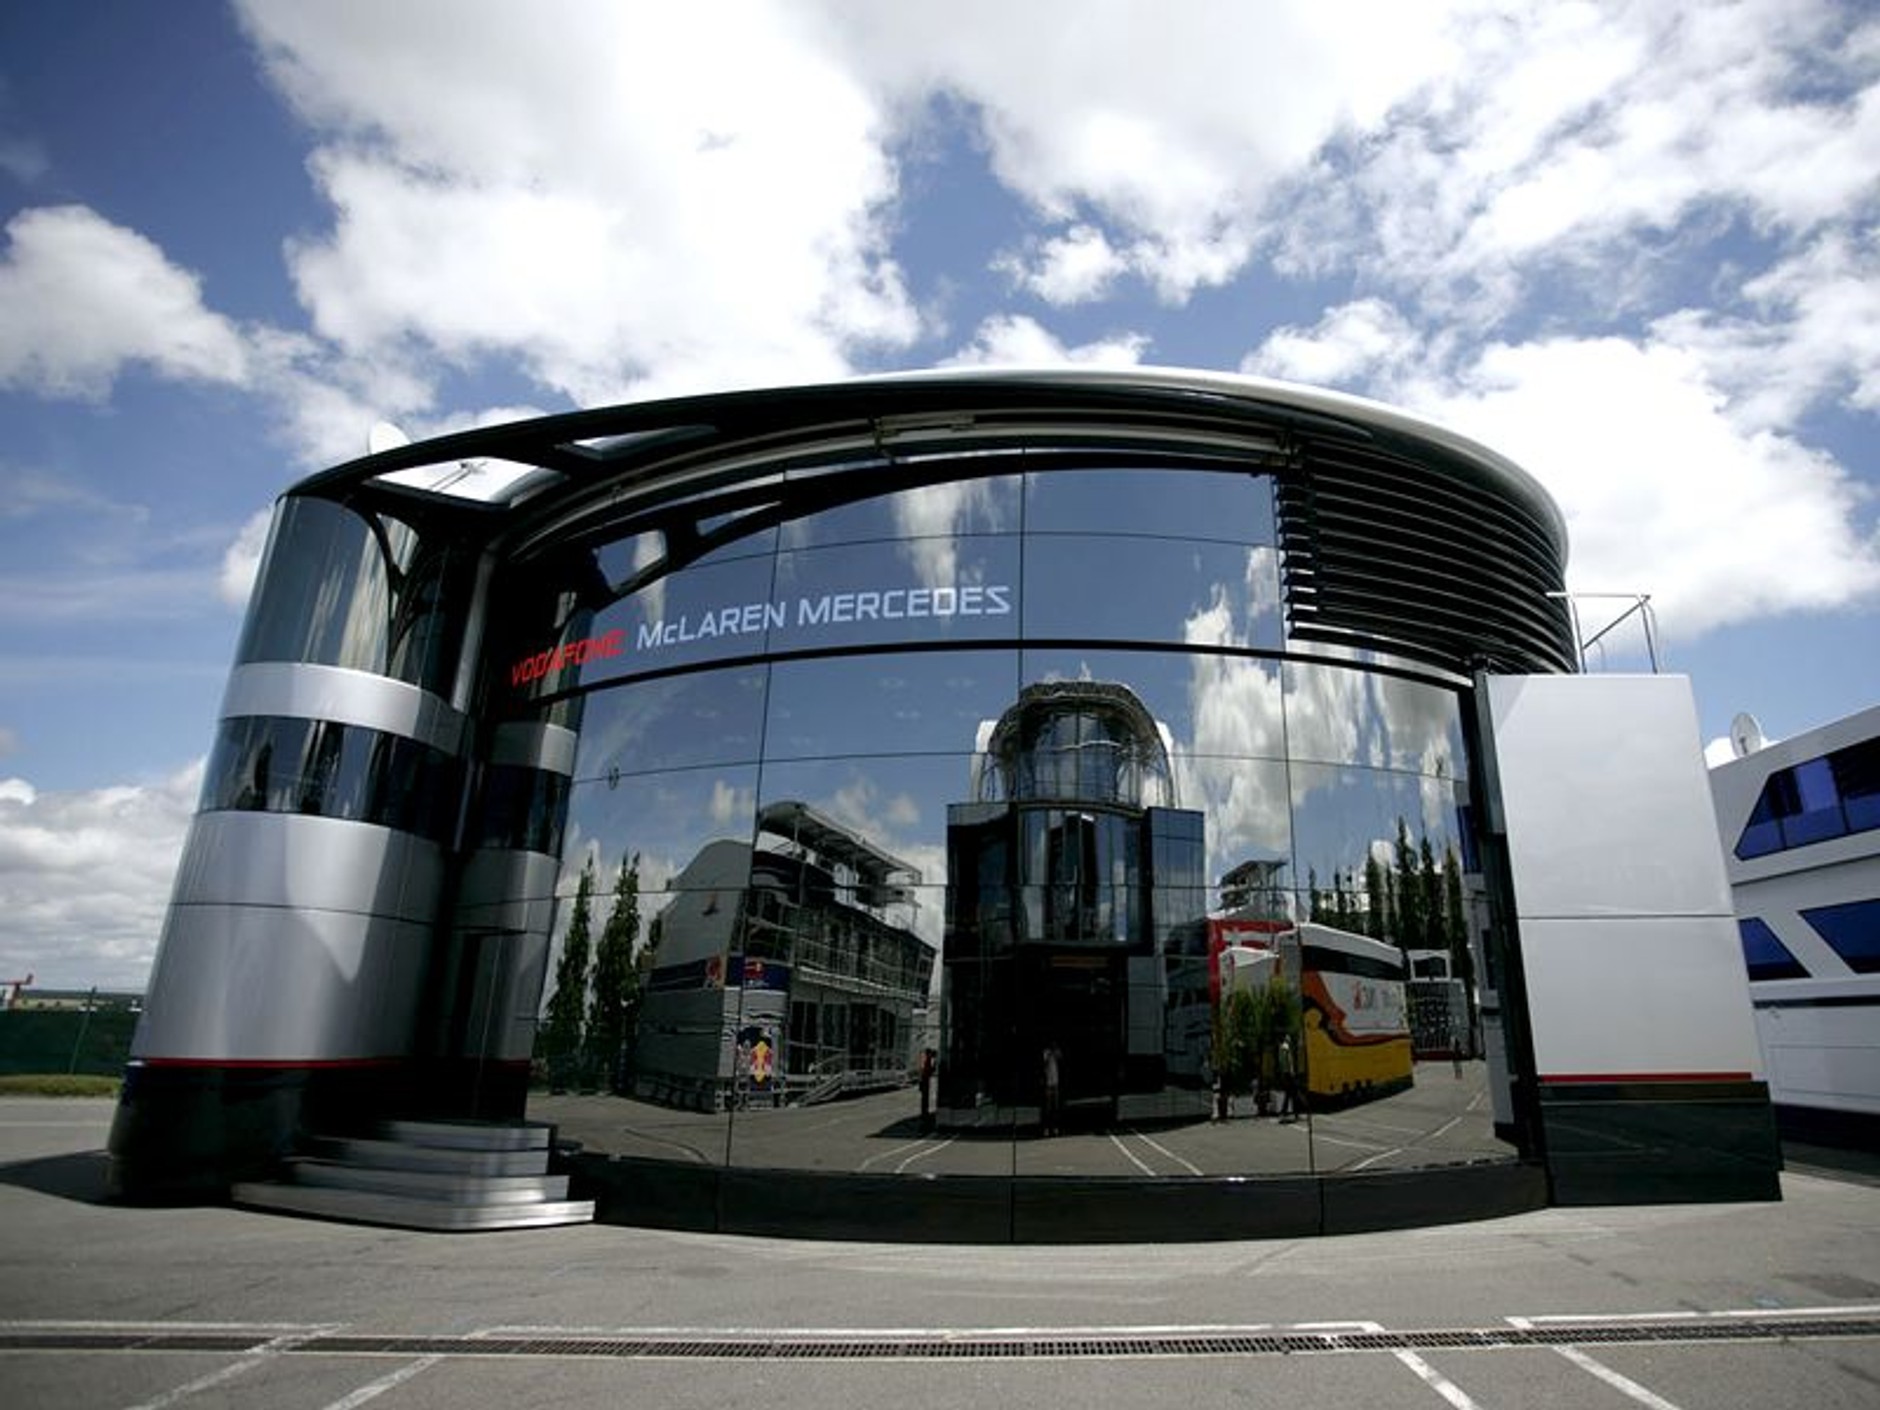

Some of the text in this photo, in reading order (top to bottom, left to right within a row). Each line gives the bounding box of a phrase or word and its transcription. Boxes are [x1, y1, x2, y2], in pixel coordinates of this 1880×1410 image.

[512, 586, 1012, 688] VODAFONE McLAREN MERCEDES
